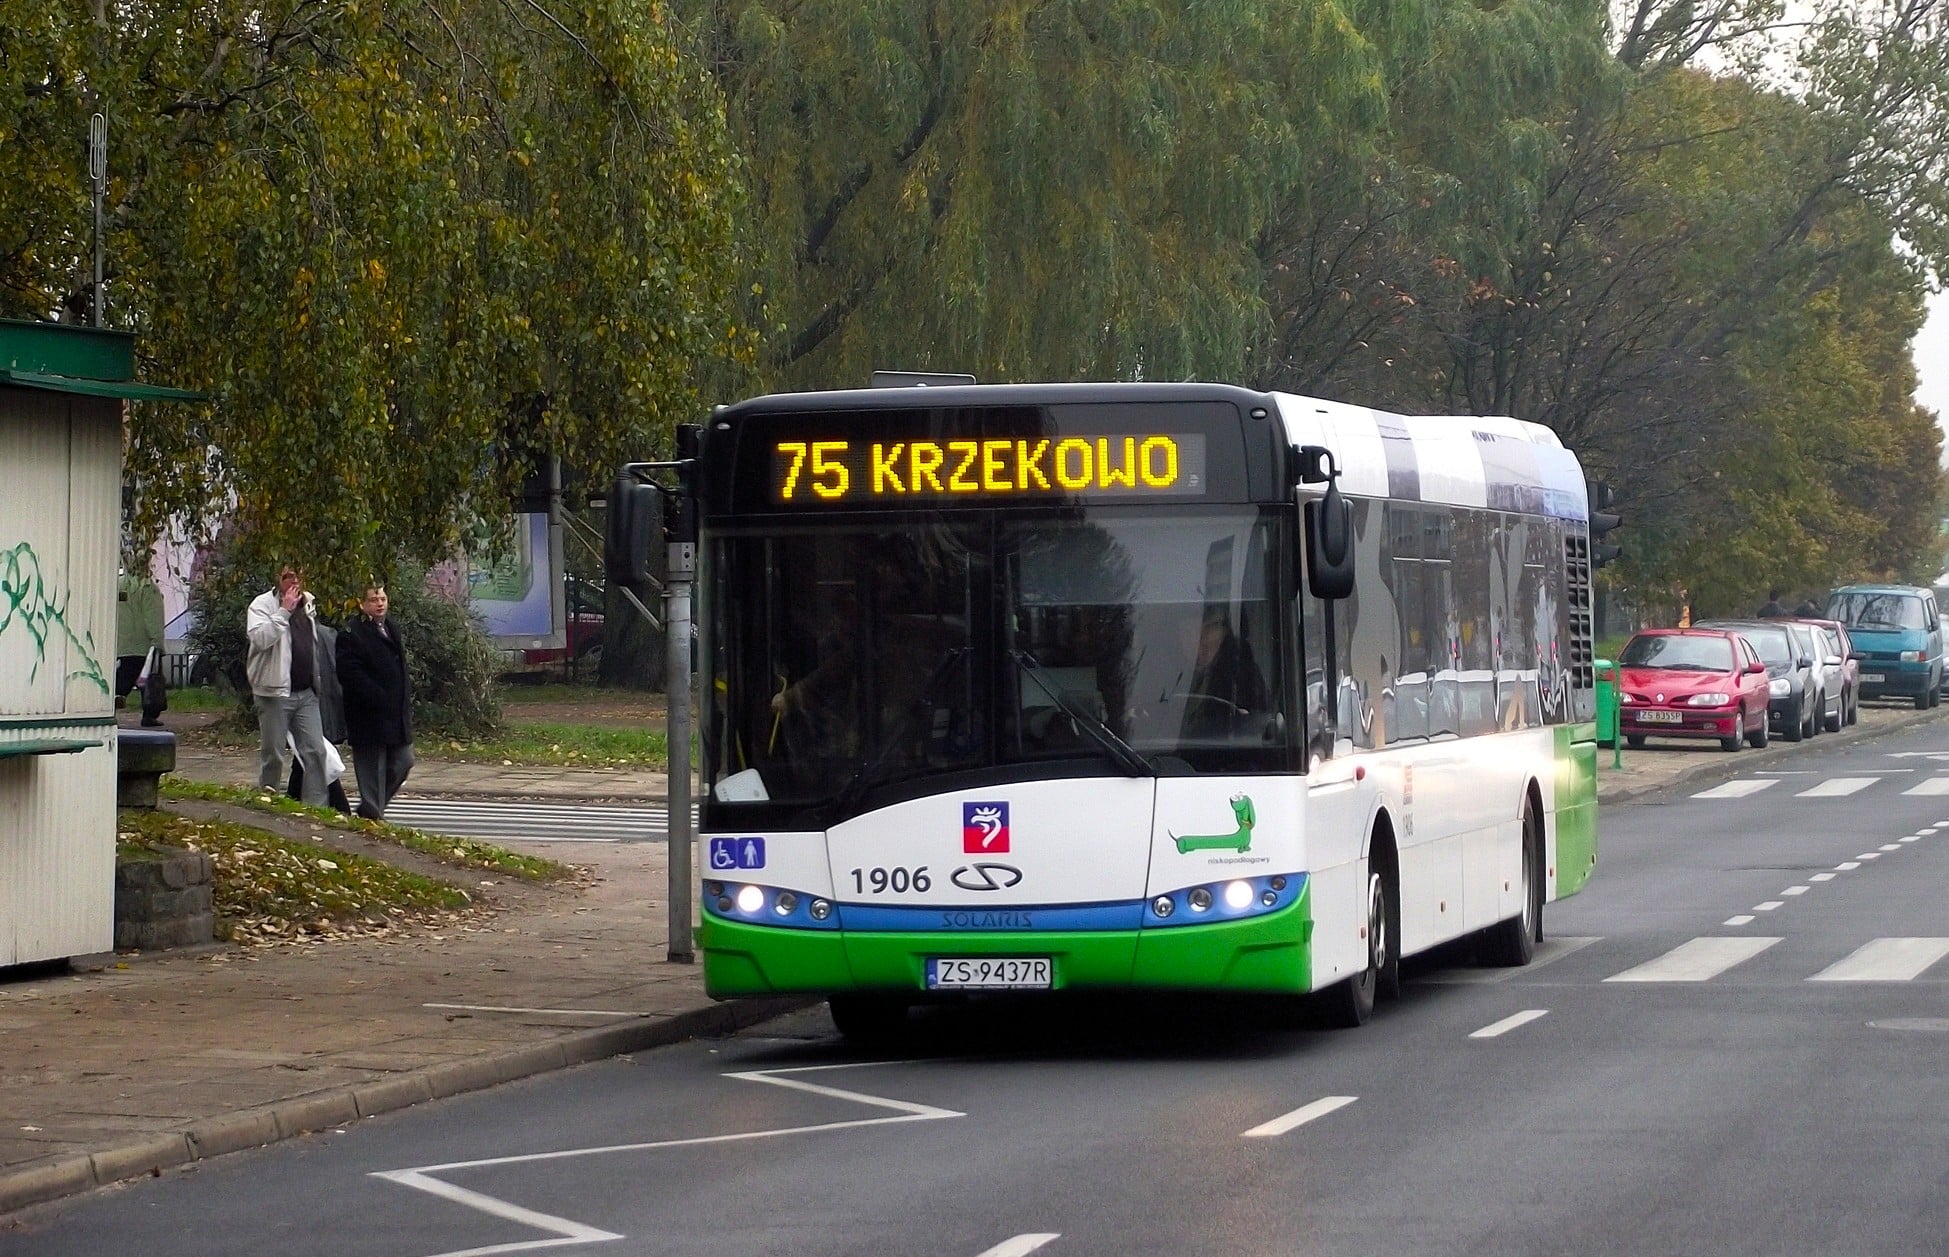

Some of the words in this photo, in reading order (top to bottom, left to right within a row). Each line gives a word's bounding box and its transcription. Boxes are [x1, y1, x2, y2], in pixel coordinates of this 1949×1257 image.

[777, 440, 850, 499] 75
[872, 435, 1179, 493] KRZEKOWO
[1641, 711, 1654, 720] ZS
[851, 866, 932, 894] 1906
[941, 912, 1033, 928] SOLARIS
[941, 961, 972, 982] ZS
[980, 961, 1047, 982] 9437R
